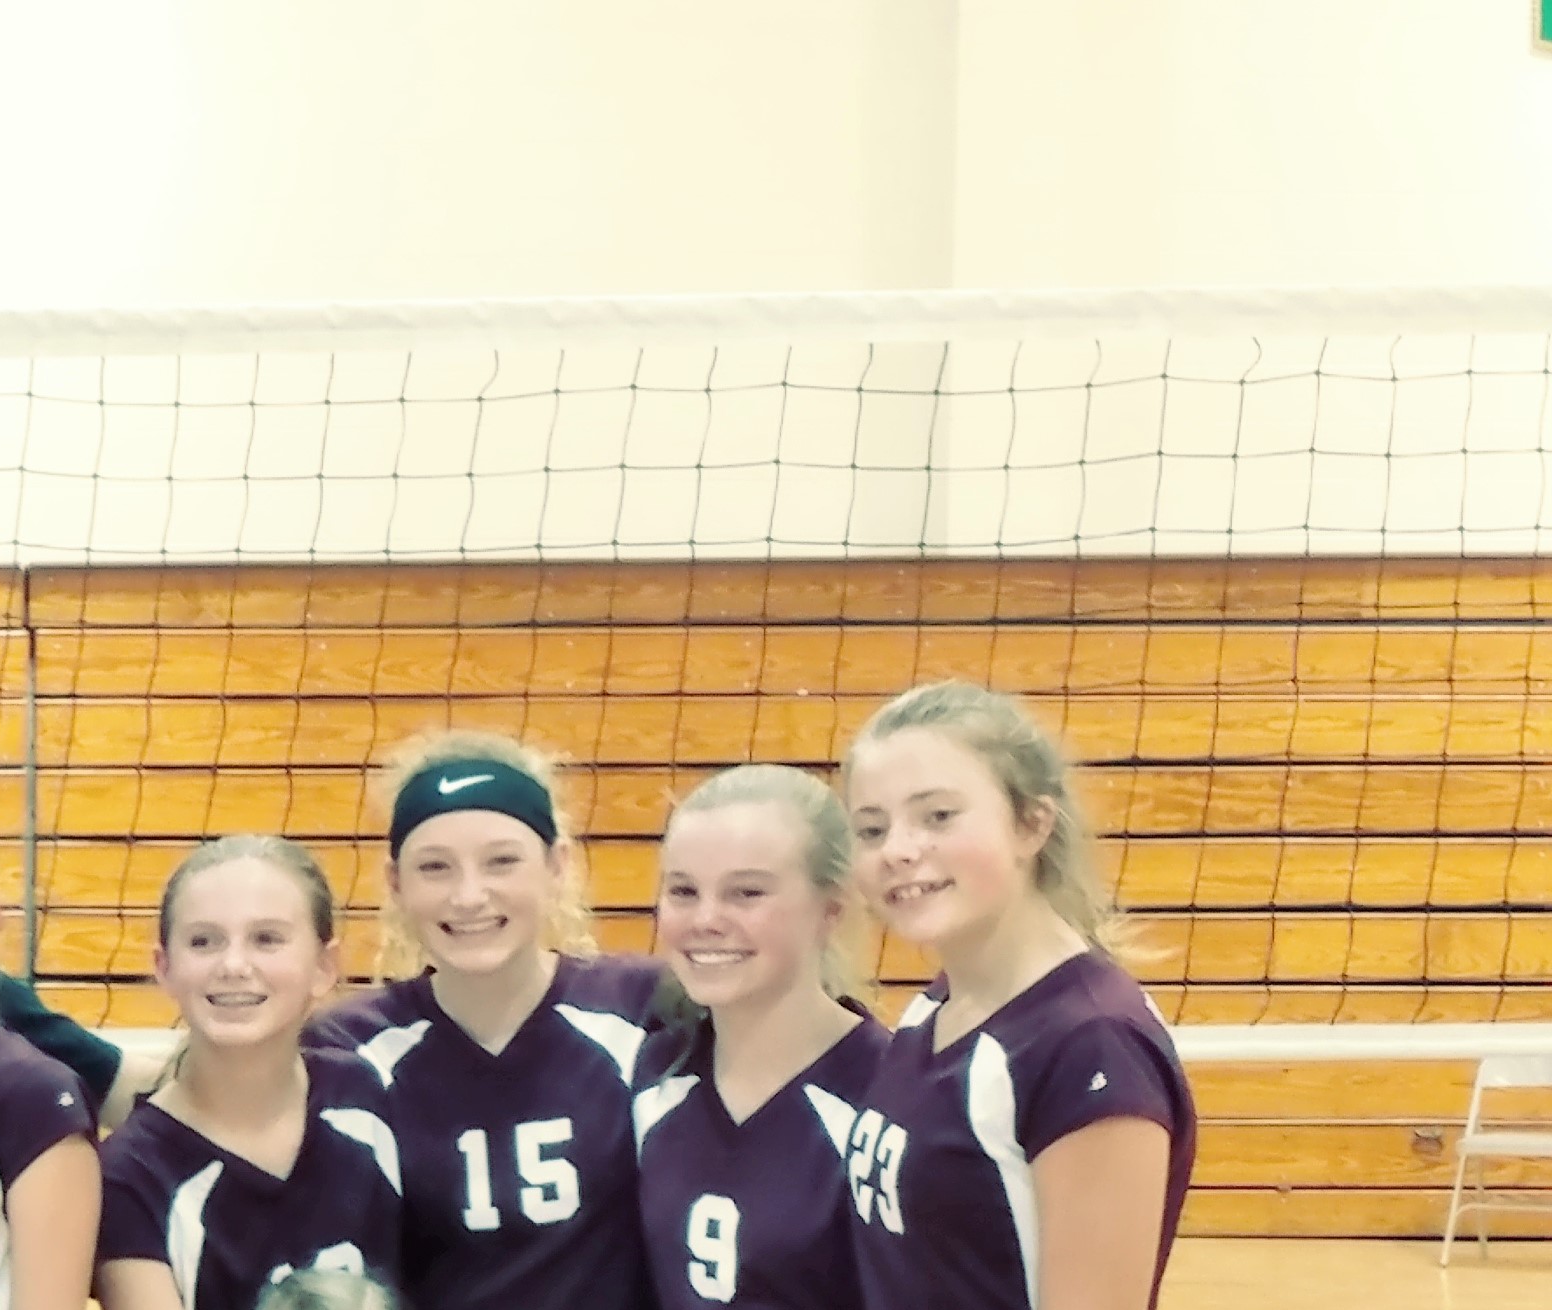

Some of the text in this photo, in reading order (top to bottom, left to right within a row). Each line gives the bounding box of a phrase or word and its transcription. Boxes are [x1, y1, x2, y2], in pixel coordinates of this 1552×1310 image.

[457, 1117, 581, 1231] 15
[849, 1107, 908, 1235] 23
[687, 1193, 740, 1303] 9
